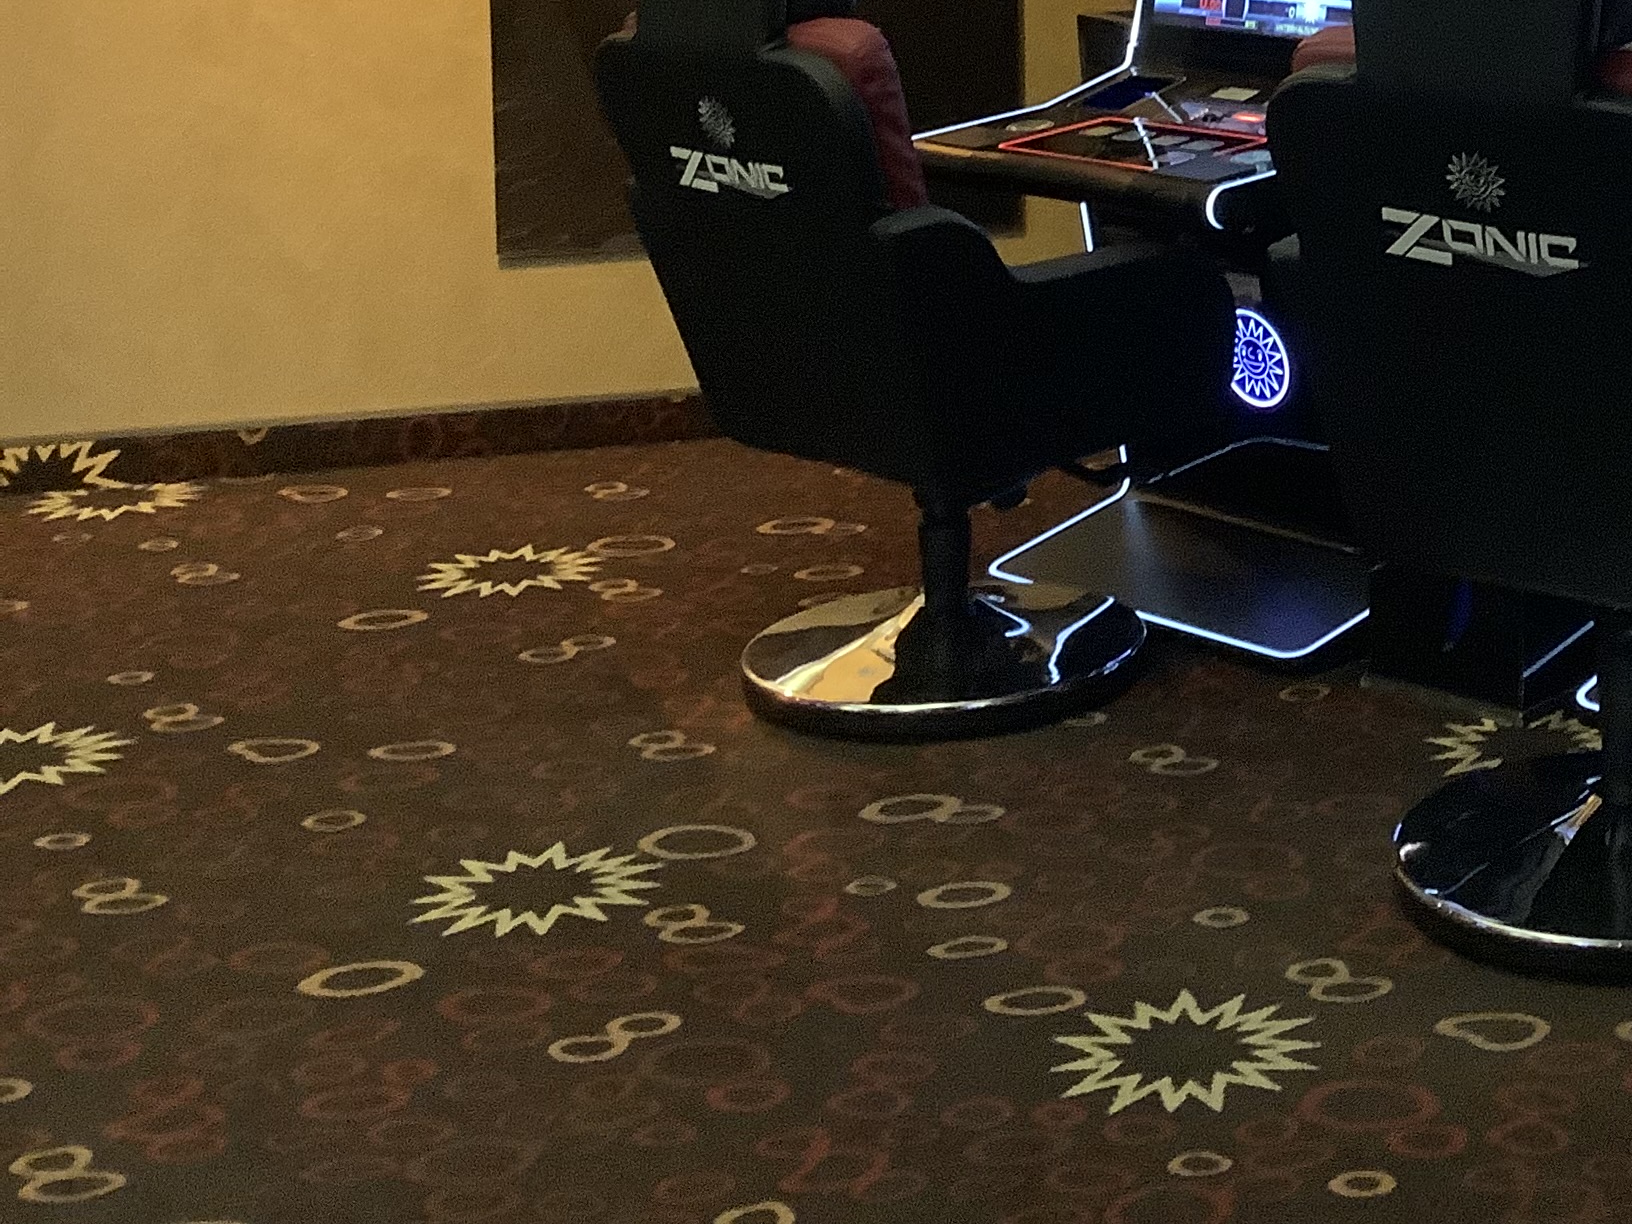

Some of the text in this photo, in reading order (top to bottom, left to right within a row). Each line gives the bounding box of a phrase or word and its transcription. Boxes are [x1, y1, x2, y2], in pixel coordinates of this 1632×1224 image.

[1288, 7, 1296, 18] 0
[670, 146, 789, 193] ZONIC
[1382, 207, 1579, 266] ZONIC
